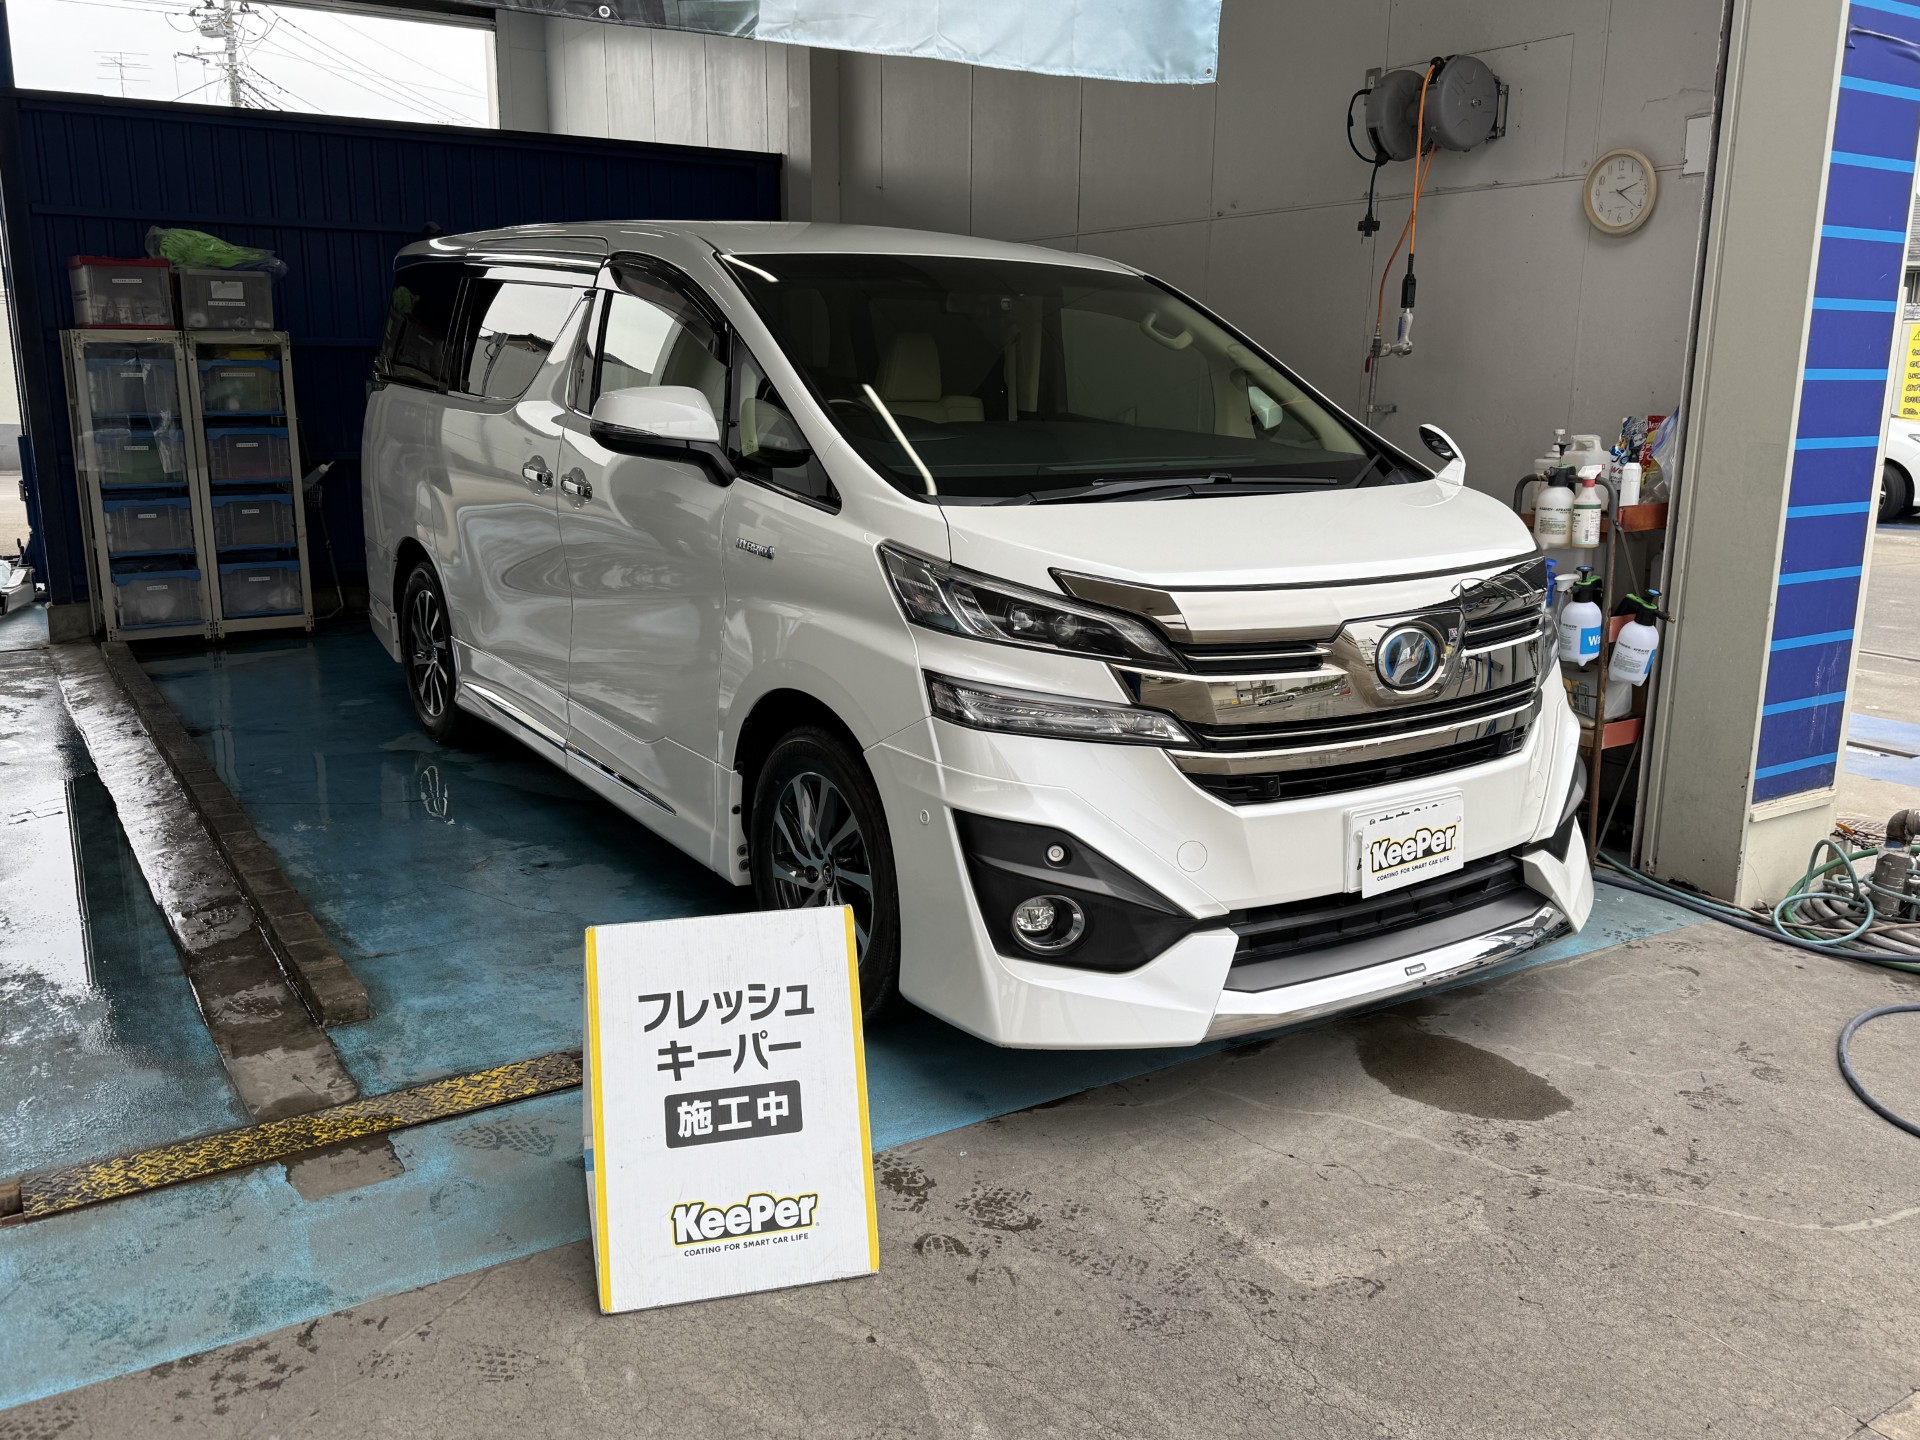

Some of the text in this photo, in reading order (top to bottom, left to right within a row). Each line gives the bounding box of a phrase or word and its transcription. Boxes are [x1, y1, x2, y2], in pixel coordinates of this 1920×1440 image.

[1370, 825, 1456, 873] KeePer
[1376, 855, 1450, 882] COATING FOR SMART CAR LIFE
[638, 983, 815, 1033] フレッシュ
[657, 1029, 802, 1082] キーパー
[677, 1090, 790, 1138] 施工中
[671, 1193, 818, 1245] KeePer
[684, 1232, 809, 1257] COATING FOR SMART CAR LIFE
